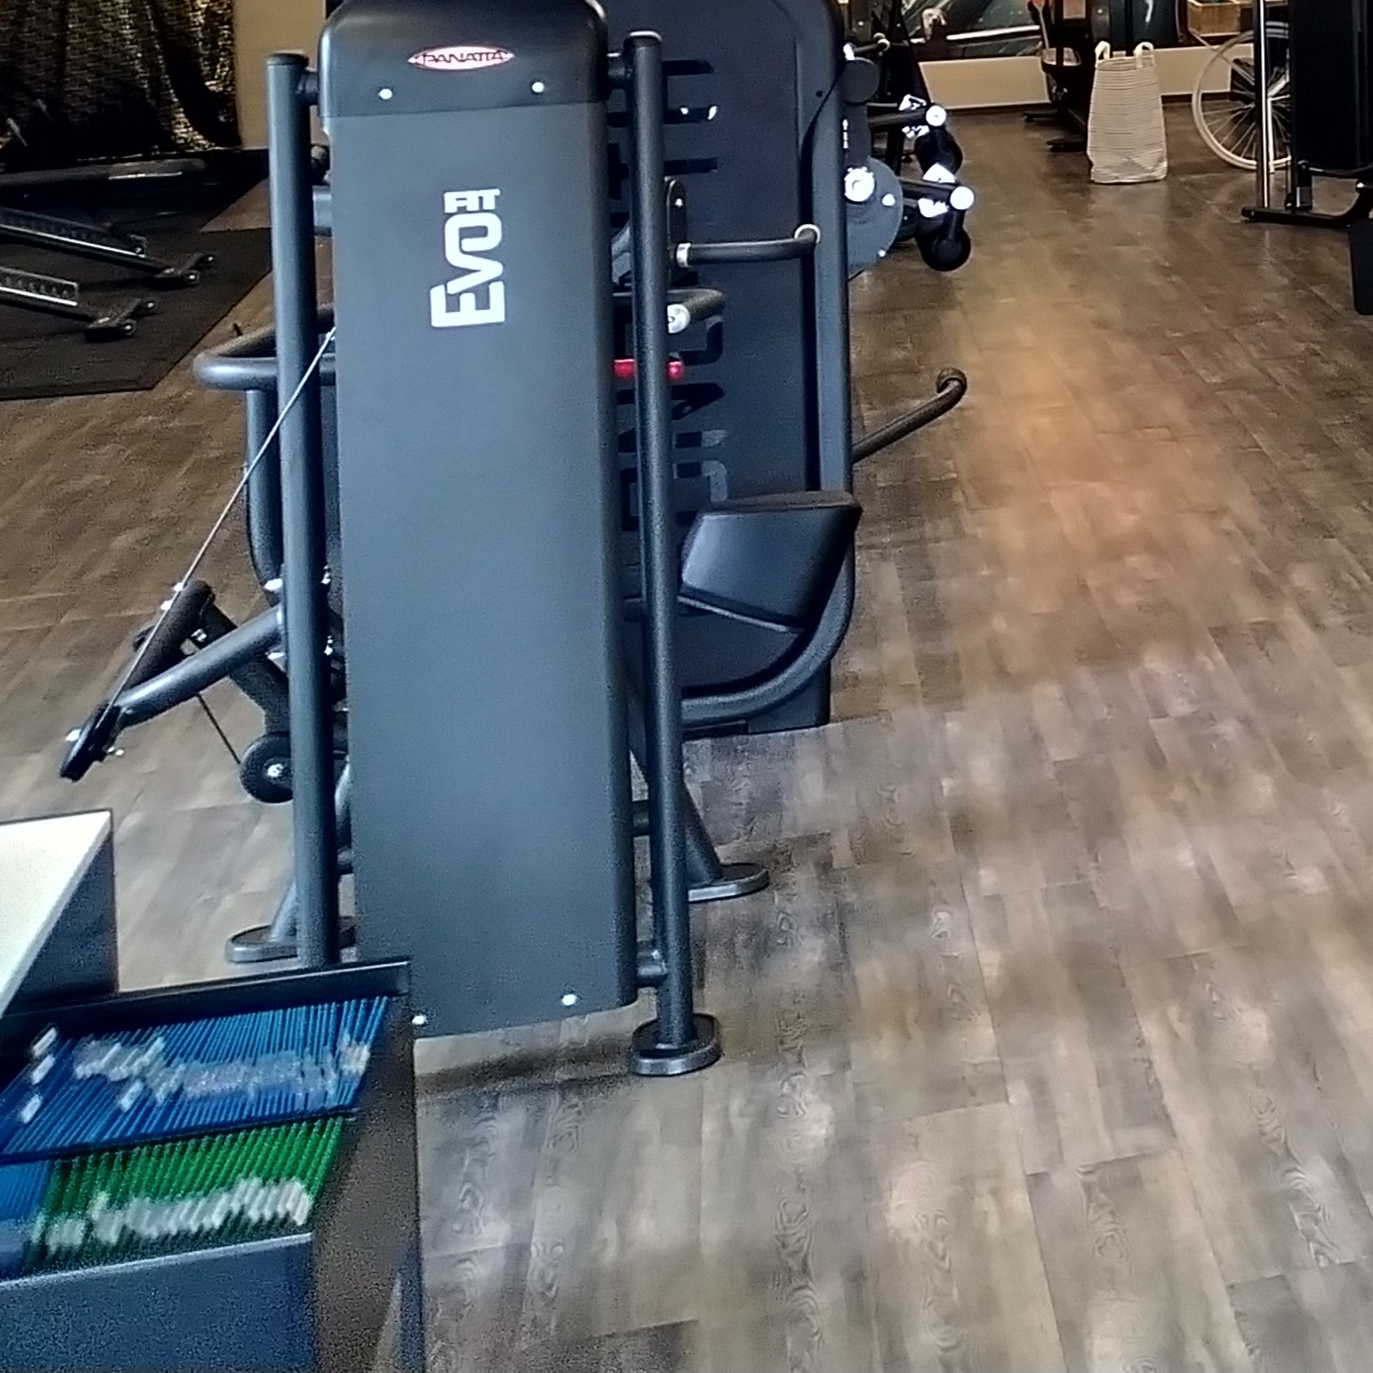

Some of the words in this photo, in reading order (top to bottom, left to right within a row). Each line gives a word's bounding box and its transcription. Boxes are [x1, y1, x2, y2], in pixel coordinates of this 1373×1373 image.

[416, 48, 508, 68] PANATTA
[444, 188, 501, 213] FIT
[430, 212, 505, 327] EVO
